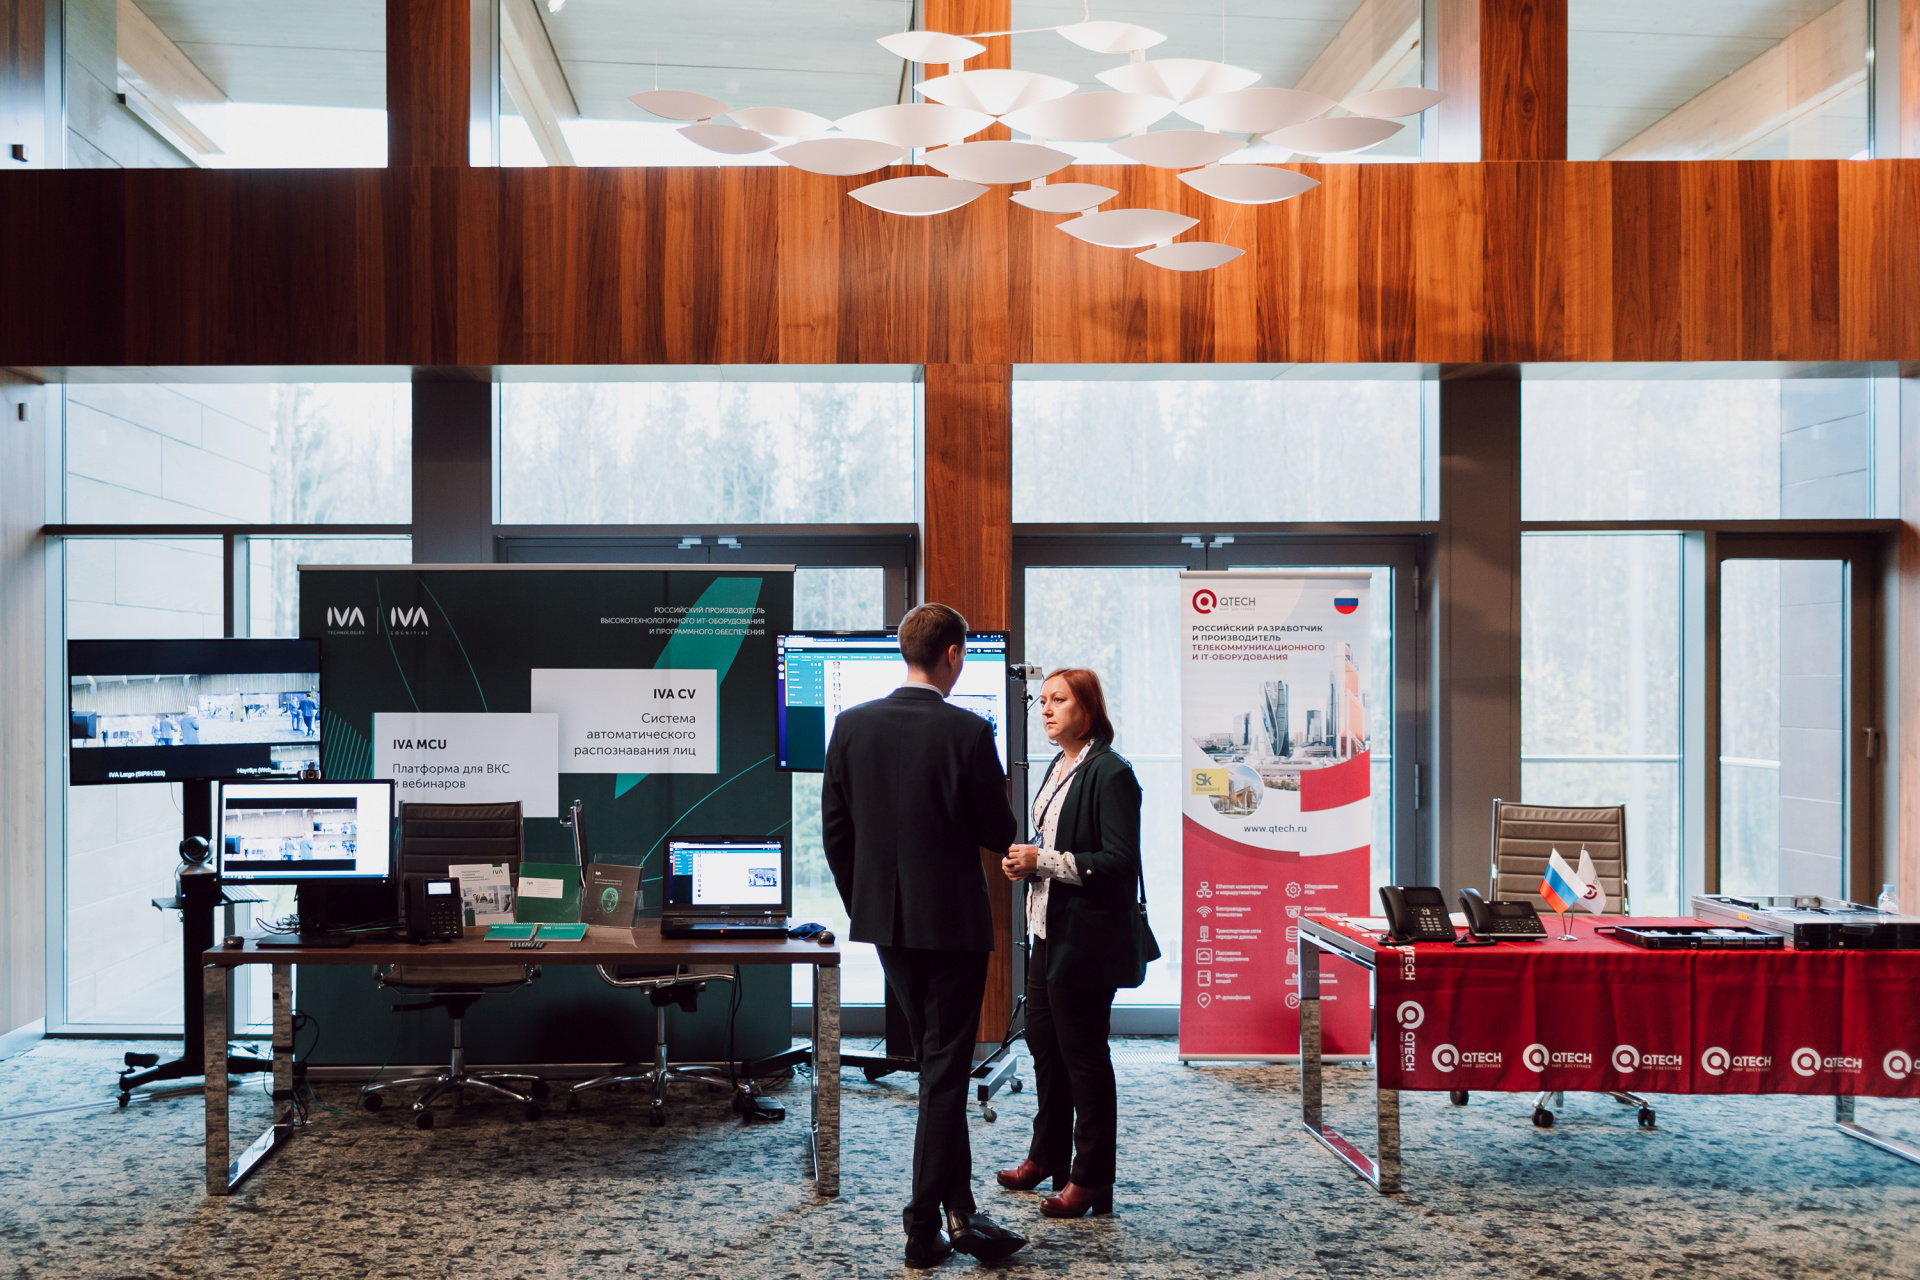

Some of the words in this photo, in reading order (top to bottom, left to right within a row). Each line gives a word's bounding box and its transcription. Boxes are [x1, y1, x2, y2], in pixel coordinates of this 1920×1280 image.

[1220, 597, 1256, 606] QTECH
[654, 606, 703, 614] РОССИЙСКИЙ
[705, 607, 765, 615] ПРОИЗВОДИТЕЛЬ
[327, 606, 365, 627] IVA
[390, 606, 429, 627] IVA
[1192, 624, 1254, 632] РОССИЙСКИЙ
[653, 689, 675, 699] IVA
[678, 689, 696, 699] CV
[641, 712, 696, 723] Система
[586, 731, 696, 739] автоматического
[393, 739, 413, 749] IVA
[417, 739, 447, 749] MCU
[574, 747, 669, 757] распознавания
[673, 747, 696, 756] лиц
[393, 764, 459, 775] Платформа
[462, 766, 483, 775] для
[487, 764, 510, 774] ВКС
[402, 779, 466, 790] вебинаров
[1195, 773, 1212, 786] Sk
[1244, 824, 1307, 834] www.qtech.ru
[1405, 1032, 1415, 1071] QTECH
[1462, 1052, 1502, 1063] QTECH
[1551, 1052, 1592, 1063] QTECH
[1642, 1054, 1682, 1066] QTECH
[1732, 1056, 1772, 1066] QTECH
[1823, 1057, 1862, 1069] QTECH
